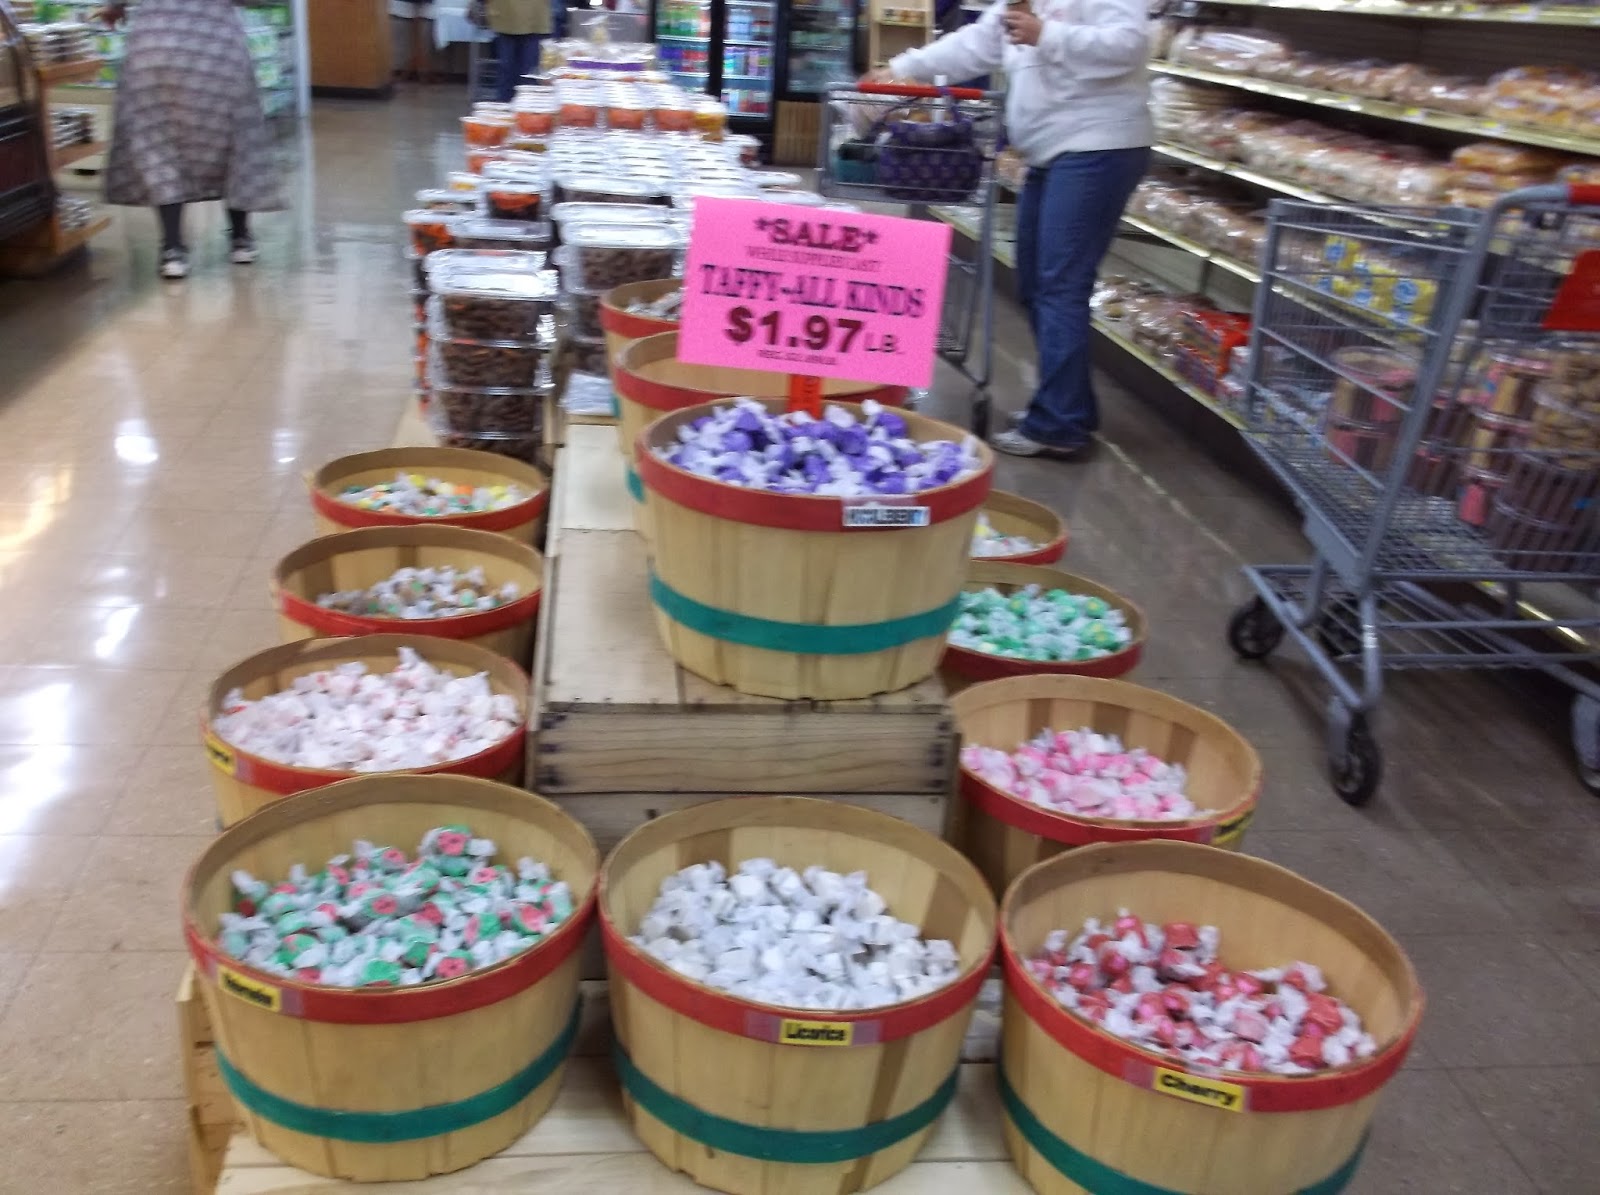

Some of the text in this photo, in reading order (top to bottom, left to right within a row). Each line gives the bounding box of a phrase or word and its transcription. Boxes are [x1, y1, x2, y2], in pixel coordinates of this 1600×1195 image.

[845, 280, 925, 318] KINDS
[726, 306, 865, 353] $1.97
[786, 1022, 845, 1042] Licorice
[1161, 1073, 1236, 1107] Cherry
